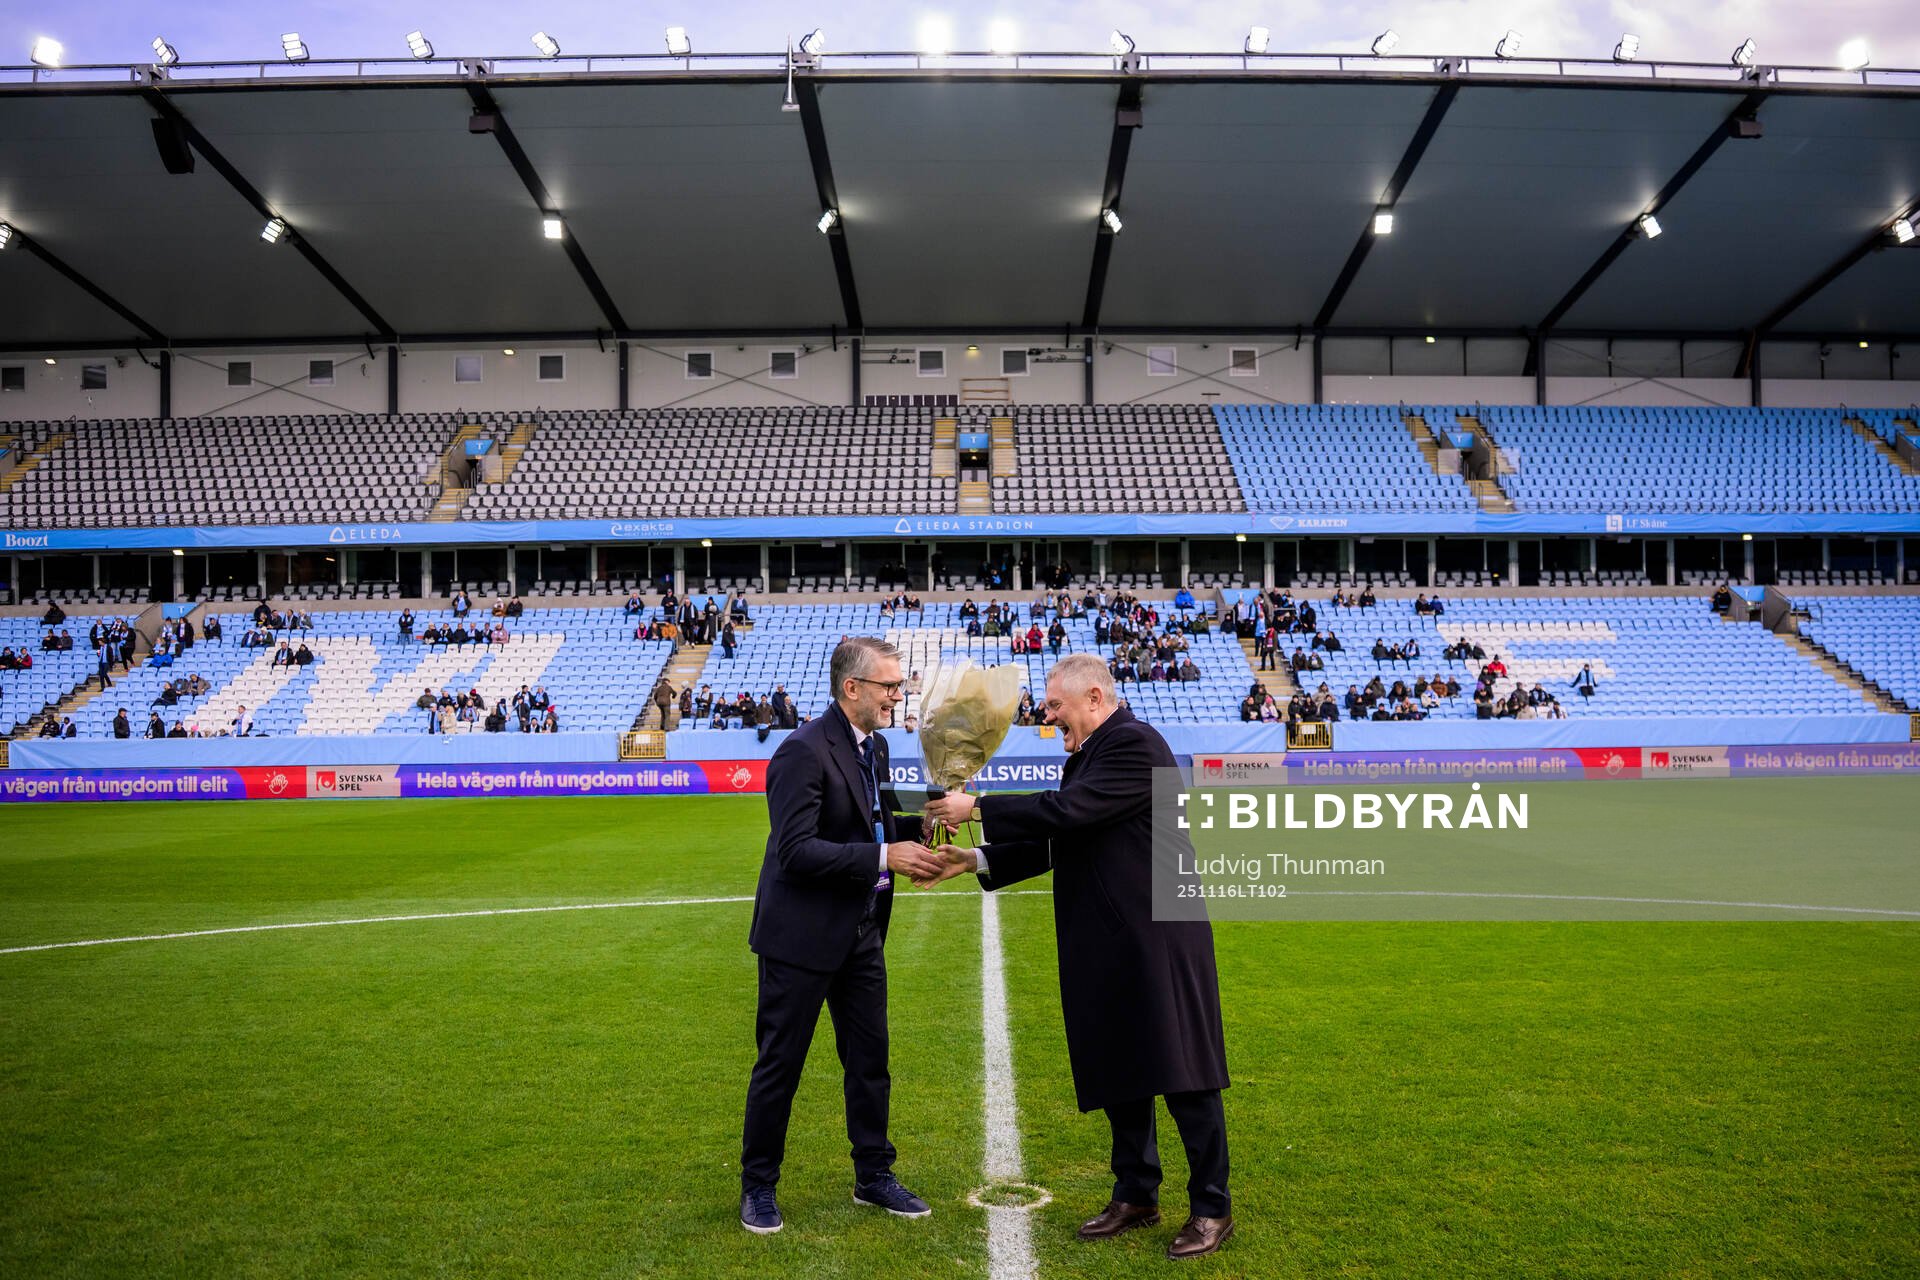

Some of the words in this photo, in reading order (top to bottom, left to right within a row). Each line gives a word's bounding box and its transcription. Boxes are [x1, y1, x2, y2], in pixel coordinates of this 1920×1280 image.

[623, 522, 674, 532] exakta
[917, 521, 961, 531] ELEDA
[969, 520, 1034, 530] STADION
[1298, 518, 1348, 528] KARATEN
[1640, 517, 1668, 528] Skåne
[350, 528, 402, 540] ELEDA
[5, 533, 49, 547] Boozt
[1672, 754, 1713, 763] SVENSKA
[1745, 753, 1782, 769] Hela
[1785, 752, 1836, 771] vägen
[1838, 751, 1869, 767] från
[1226, 762, 1270, 771] SVENSKA
[1303, 759, 1343, 776] Hela
[1346, 758, 1402, 779] vägen
[1404, 758, 1436, 775] från
[1440, 757, 1514, 777] ungdom
[1516, 756, 1537, 774] till
[1540, 755, 1567, 774] elit
[1672, 763, 1694, 771] SPEL
[339, 774, 383, 783] SVENSKA
[972, 764, 1065, 782] LLSVENS
[1226, 771, 1249, 779] SPEL
[5, 777, 60, 797] vägen
[63, 776, 96, 793] från
[99, 775, 174, 796] ungdom
[176, 776, 198, 793] till
[200, 775, 229, 793] elit
[417, 772, 458, 788] Hela
[460, 771, 517, 792] vägen
[519, 770, 554, 788] från
[557, 770, 634, 791] ungdom
[636, 769, 659, 787] till
[661, 769, 690, 787] elit
[339, 783, 362, 792] SPEL
